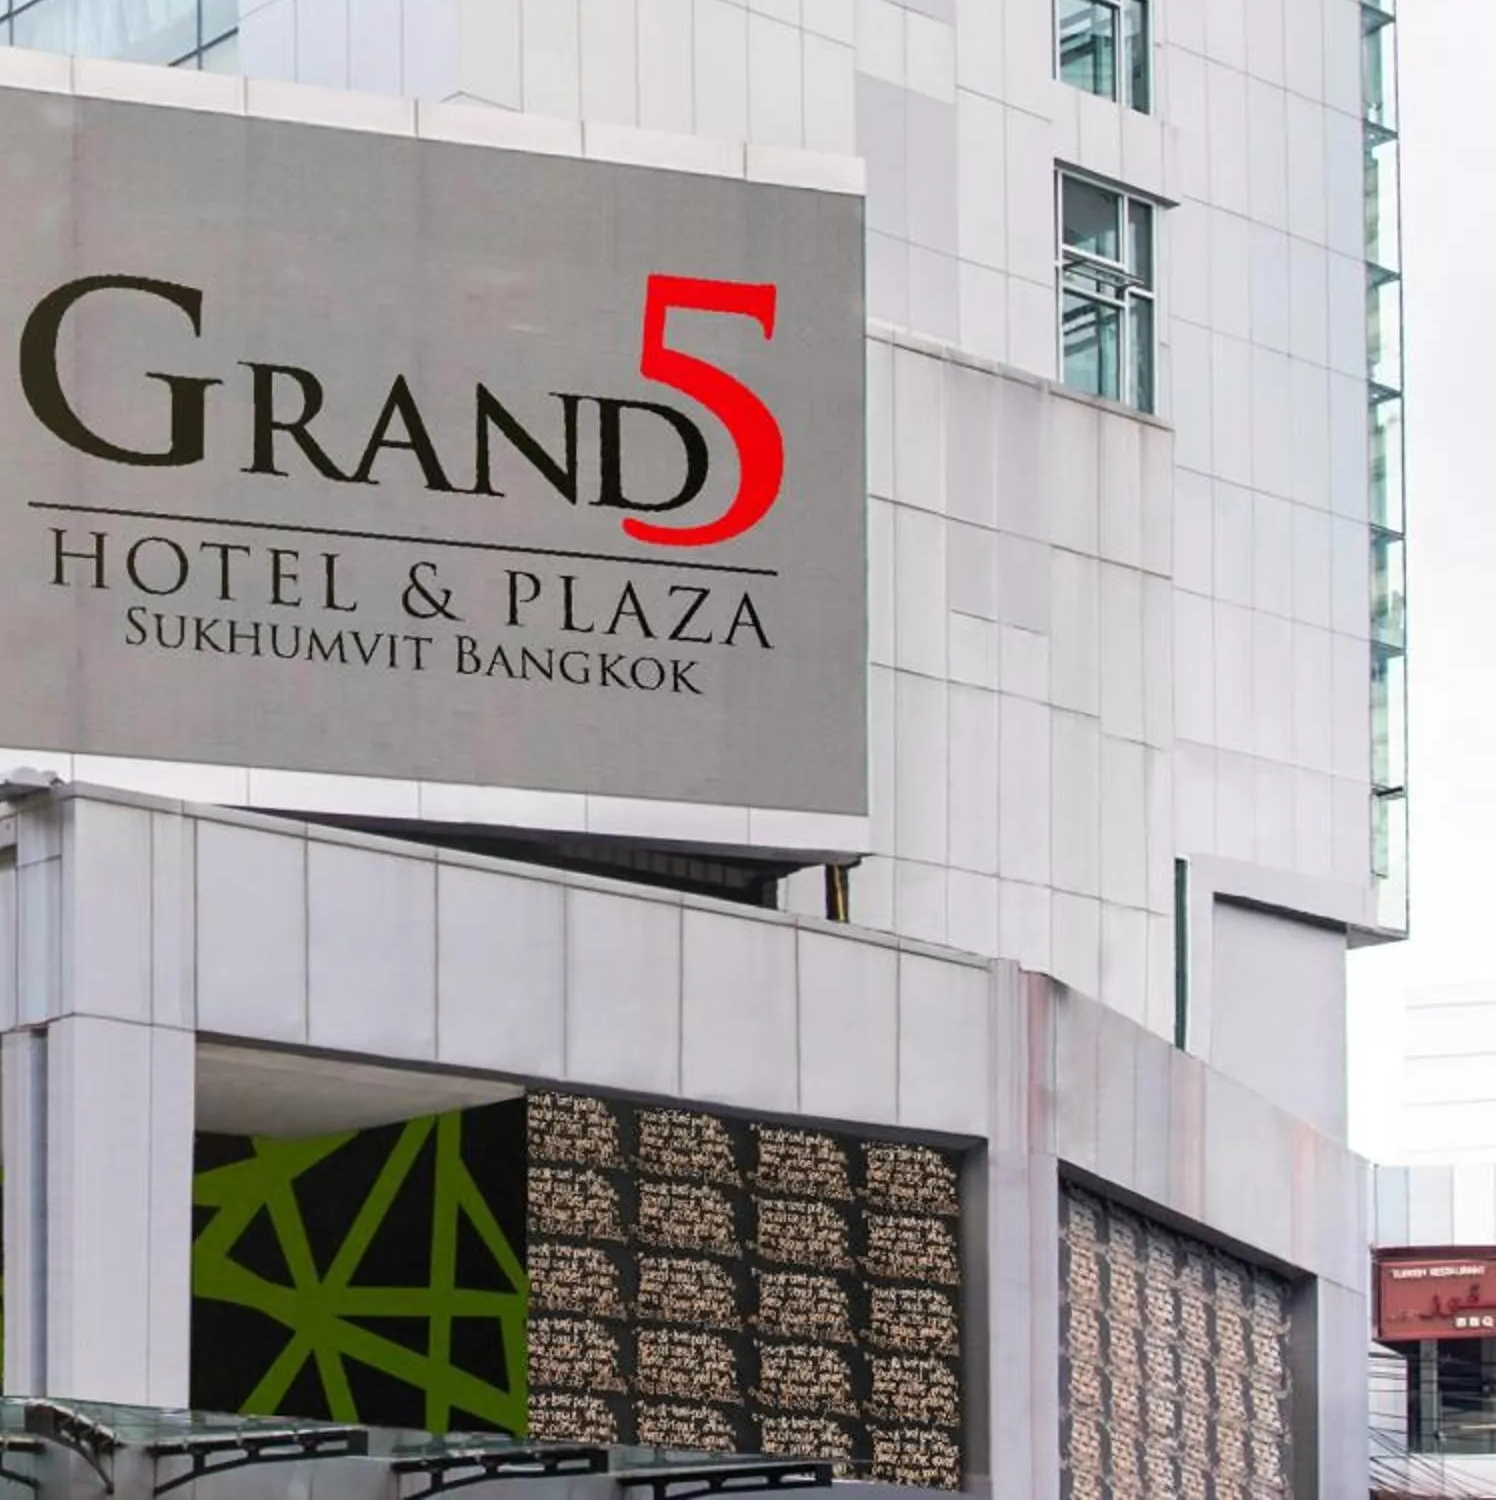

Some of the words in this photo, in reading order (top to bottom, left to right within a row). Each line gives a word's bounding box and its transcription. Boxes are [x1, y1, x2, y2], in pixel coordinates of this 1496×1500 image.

[52, 528, 357, 612] HOTEL
[401, 561, 460, 621] &
[504, 569, 773, 649] PLAZA
[127, 606, 433, 671] SUKHUMVIT
[456, 635, 702, 695] BANGKOK
